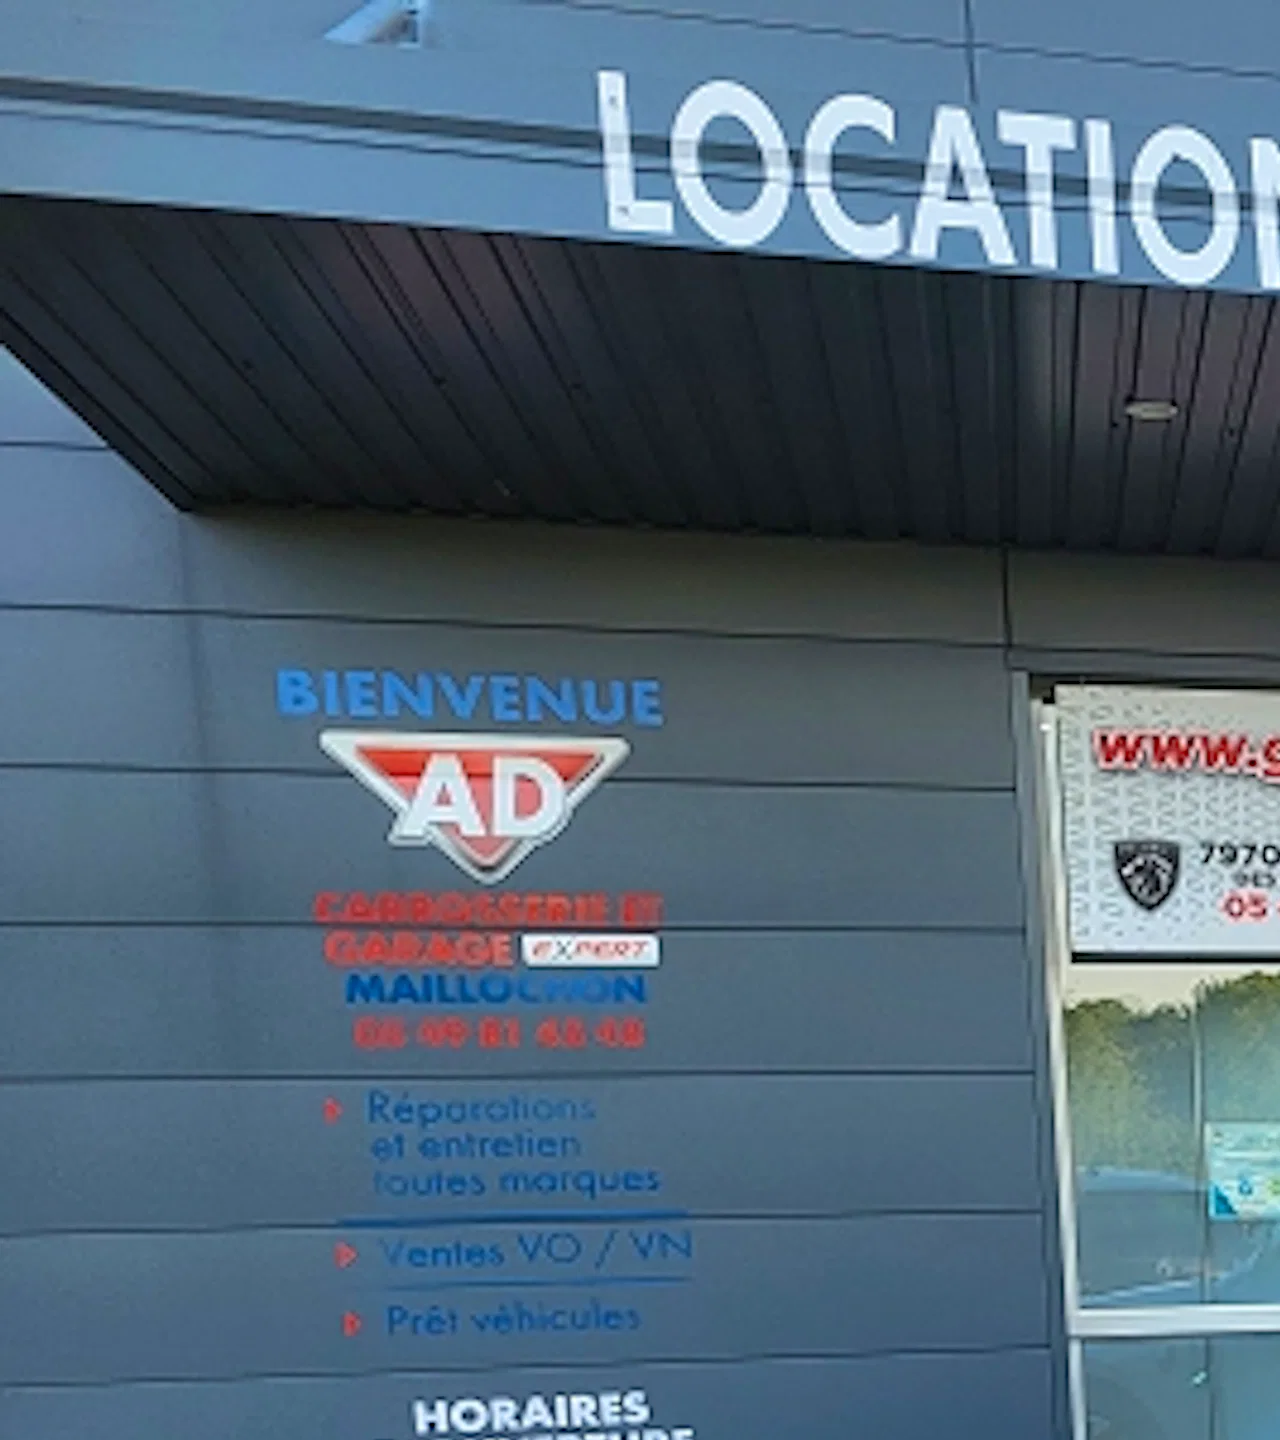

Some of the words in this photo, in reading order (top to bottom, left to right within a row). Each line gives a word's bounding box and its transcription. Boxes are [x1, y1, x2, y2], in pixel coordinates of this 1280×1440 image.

[276, 669, 664, 727] BIENVENUE
[397, 752, 568, 838] AD
[314, 891, 609, 926] CARROSSERIE
[620, 891, 664, 928] ET
[1222, 896, 1269, 921] 05
[324, 931, 514, 968] GARAGE
[346, 974, 647, 1004] MAILLOCHON
[367, 1089, 597, 1130] Réparations
[371, 1131, 405, 1160] et
[419, 1130, 581, 1158] entretien
[373, 1168, 486, 1197] toutes
[500, 1167, 661, 1199] marques
[380, 1237, 505, 1269] Ventes
[516, 1231, 583, 1263] VO
[629, 1230, 693, 1261] VN
[387, 1304, 458, 1336] Prêt
[471, 1301, 641, 1334] véhicules
[413, 1390, 651, 1435] HORAIRES
